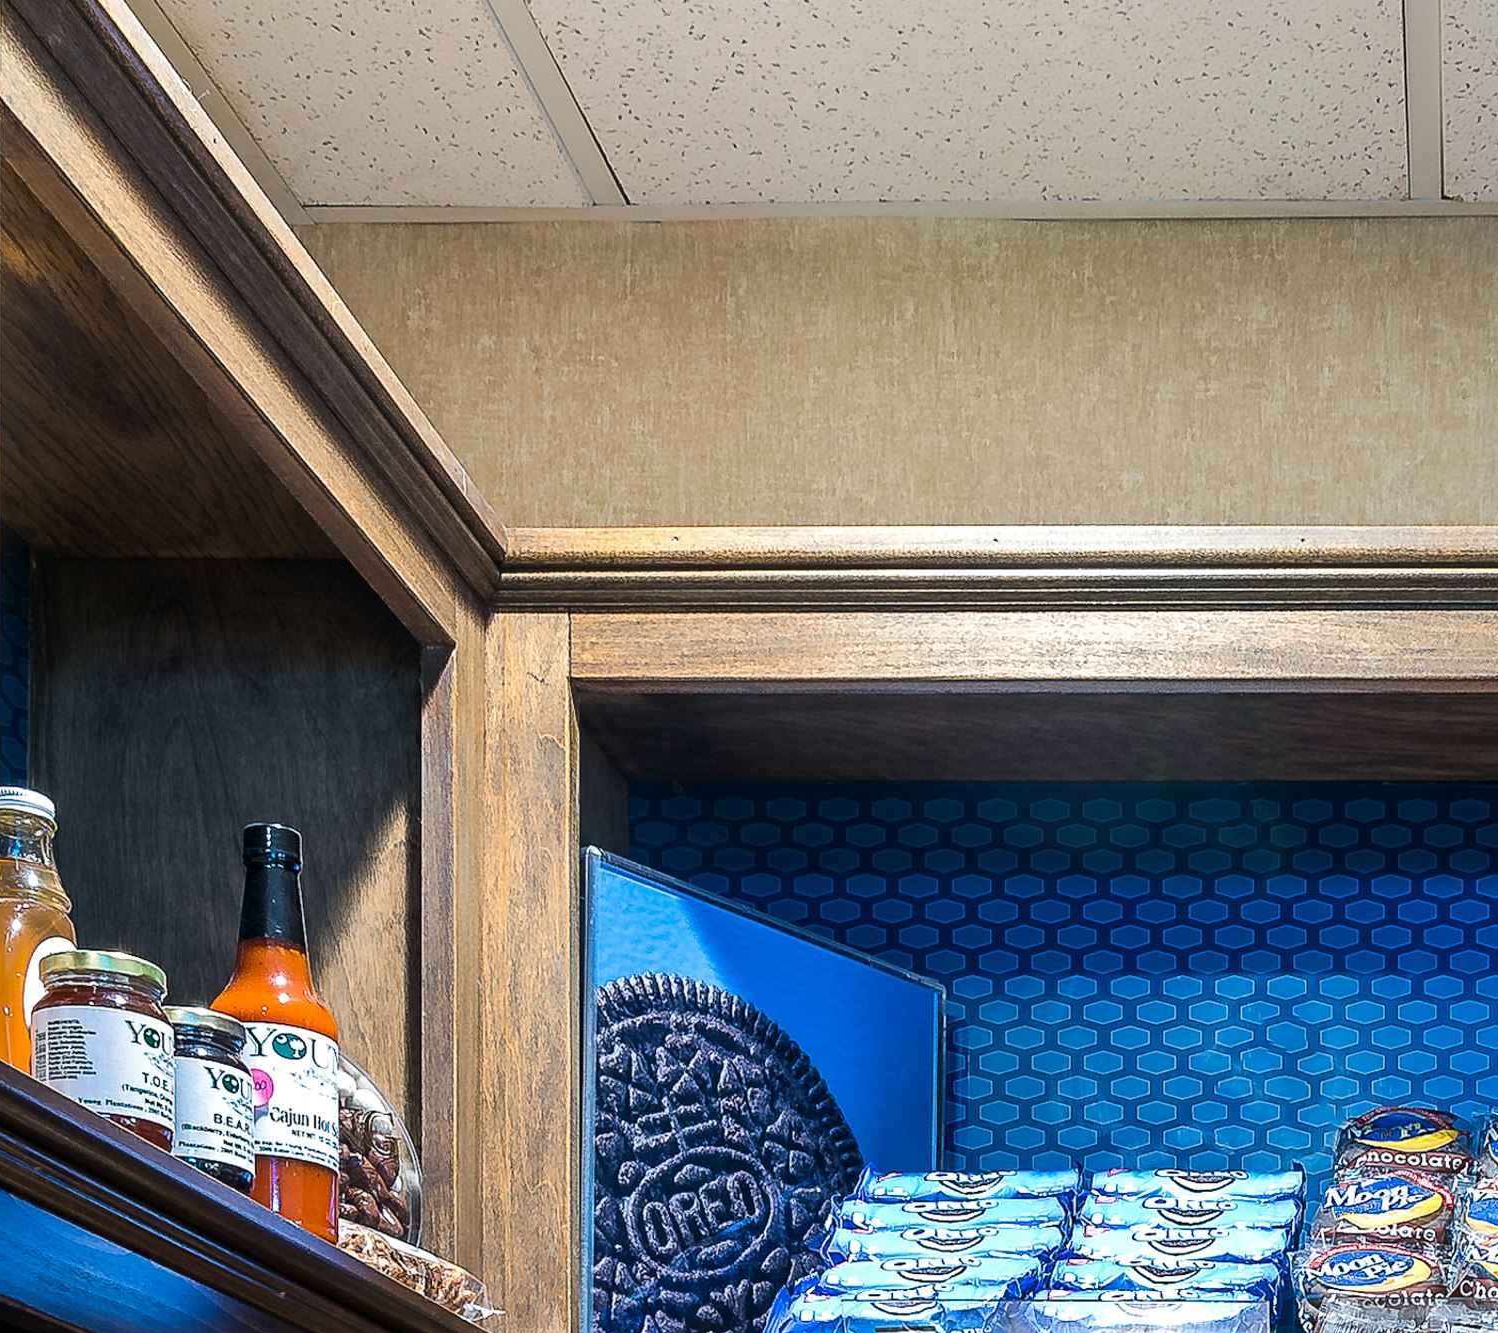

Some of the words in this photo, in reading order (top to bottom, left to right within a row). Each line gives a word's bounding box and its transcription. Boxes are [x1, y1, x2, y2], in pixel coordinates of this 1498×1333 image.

[270, 1106, 309, 1127] Cajun
[1326, 1185, 1409, 1207] Moon
[1307, 1254, 1384, 1277] Moon
[1366, 1259, 1412, 1279] Pie
